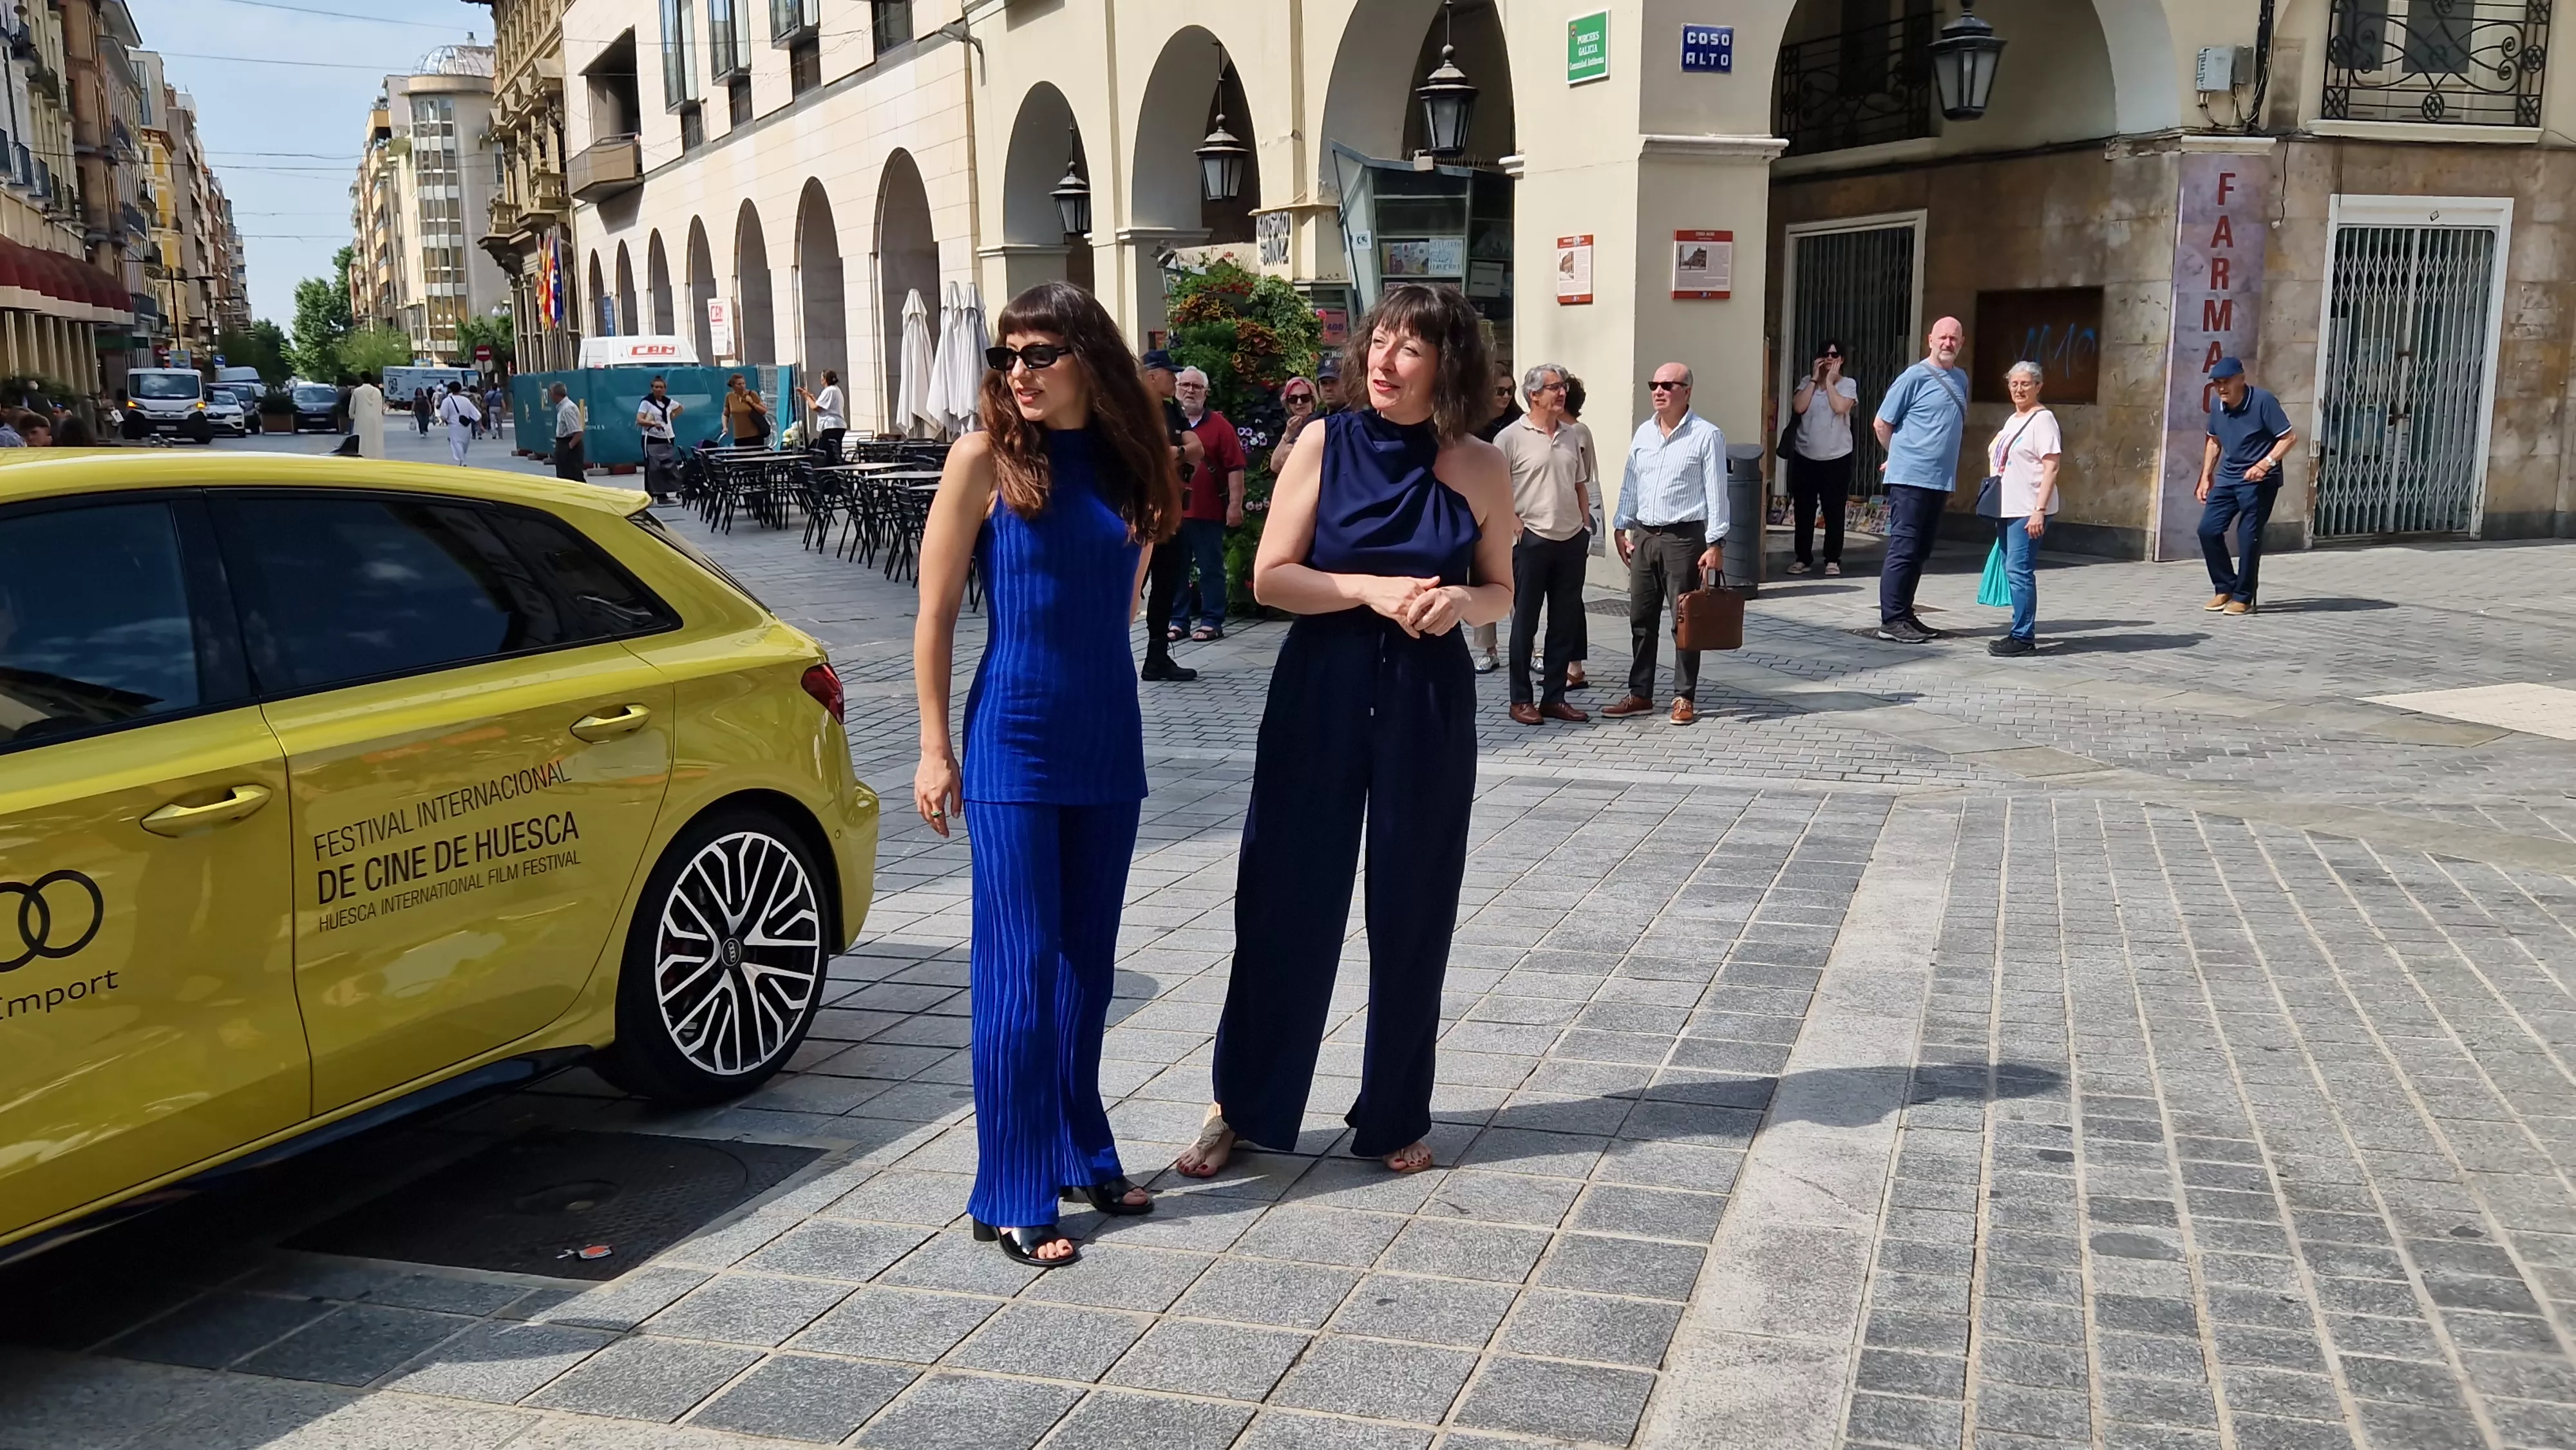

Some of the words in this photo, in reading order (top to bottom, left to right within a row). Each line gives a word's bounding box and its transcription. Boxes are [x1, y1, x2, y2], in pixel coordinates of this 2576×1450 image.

[1687, 32, 1730, 46] COSO
[1686, 52, 1728, 66] ALTO
[1256, 211, 1290, 238] KIOSKO
[1260, 238, 1289, 265] SANZ
[631, 345, 676, 356] CAM
[314, 809, 414, 862] FESTIVAL
[416, 760, 573, 829] INTERNACIONAL
[317, 863, 357, 905] DE
[365, 845, 428, 891] CINE
[433, 834, 469, 874] DE
[475, 811, 580, 862] HUESCA
[319, 904, 376, 932] HUESCA
[380, 872, 484, 916] INTERNATIONAL
[488, 863, 519, 885] FILM
[522, 849, 581, 878] FESTIVAL
[0, 970, 118, 1021] mport
